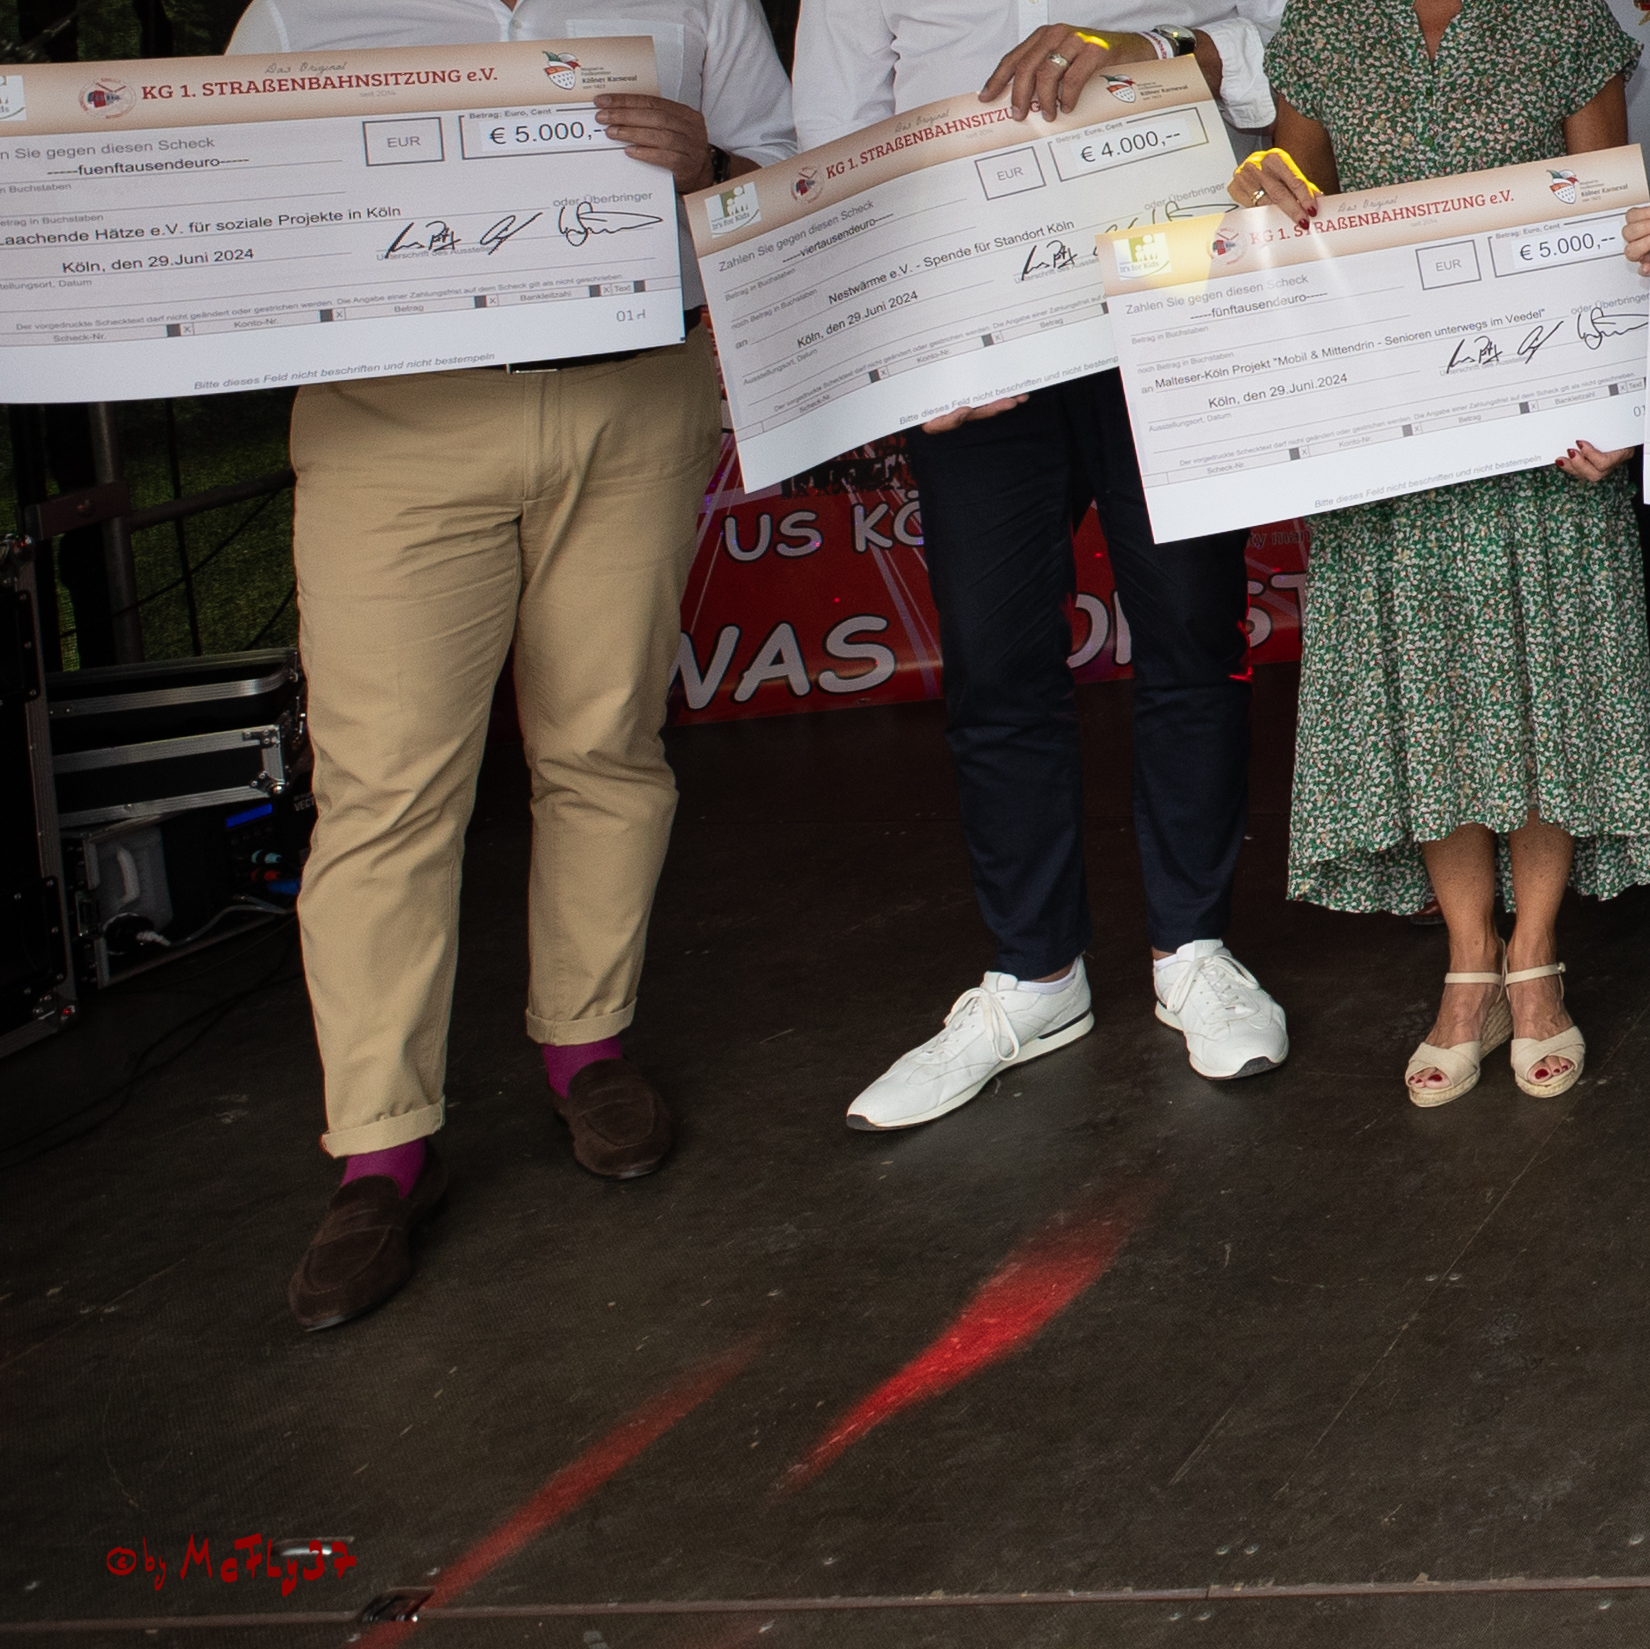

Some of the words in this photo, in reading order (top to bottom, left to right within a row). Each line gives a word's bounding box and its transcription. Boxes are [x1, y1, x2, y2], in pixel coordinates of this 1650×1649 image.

[141, 84, 174, 100] KG
[179, 84, 196, 98] 1.
[201, 69, 462, 97] STRAßENBAHNSITZUNG
[466, 67, 498, 82] e.V.
[386, 135, 422, 149] EUR
[489, 127, 507, 145] €
[515, 121, 606, 143] 5.000,-
[825, 161, 846, 180] KG
[847, 157, 859, 171] 1.
[858, 100, 1041, 165] STRAßENBAHNSITZUG
[1080, 145, 1096, 163] €
[1101, 130, 1181, 158] 4.000,--
[0, 230, 90, 246] aachende
[94, 228, 145, 241] Hätze
[150, 223, 184, 237] e.V.
[188, 221, 211, 233] für
[215, 216, 273, 232] soziale
[278, 211, 344, 227] Projekte
[348, 209, 362, 220] in
[366, 206, 401, 219] Köln
[1249, 228, 1275, 246] KG
[1278, 227, 1291, 241] 1.
[1489, 189, 1514, 205] e.V.
[62, 261, 106, 274] Köln,
[110, 259, 143, 271] den
[147, 251, 209, 268] 29.Juni
[213, 248, 254, 263] 2024
[828, 274, 887, 305] Nestwärme
[889, 263, 913, 279] e.V.
[922, 247, 972, 268] Spende
[973, 242, 991, 254] für
[993, 227, 1046, 248] Standort
[1046, 220, 1075, 235] Köln
[1519, 244, 1534, 261] €
[1539, 232, 1616, 258] 5.000,--
[796, 331, 824, 349] Köln,
[825, 320, 846, 335] den
[846, 301, 887, 326] 29.Juni
[888, 290, 918, 309] 2024
[1154, 367, 1230, 389] Malteser-Köln
[1231, 359, 1271, 375] Projekt
[1272, 352, 1308, 366] "Mobil
[1310, 350, 1319, 360] &
[1321, 341, 1375, 358] Mittendrin
[1384, 330, 1432, 346] Senioren
[1434, 320, 1488, 337] unterwegs
[1490, 318, 1504, 327] im
[1504, 308, 1546, 324] Veedel"
[1207, 395, 1240, 409] Köln,
[1242, 390, 1267, 403] den
[1269, 372, 1348, 398] 29.Juni.2024
[724, 509, 824, 563] US
